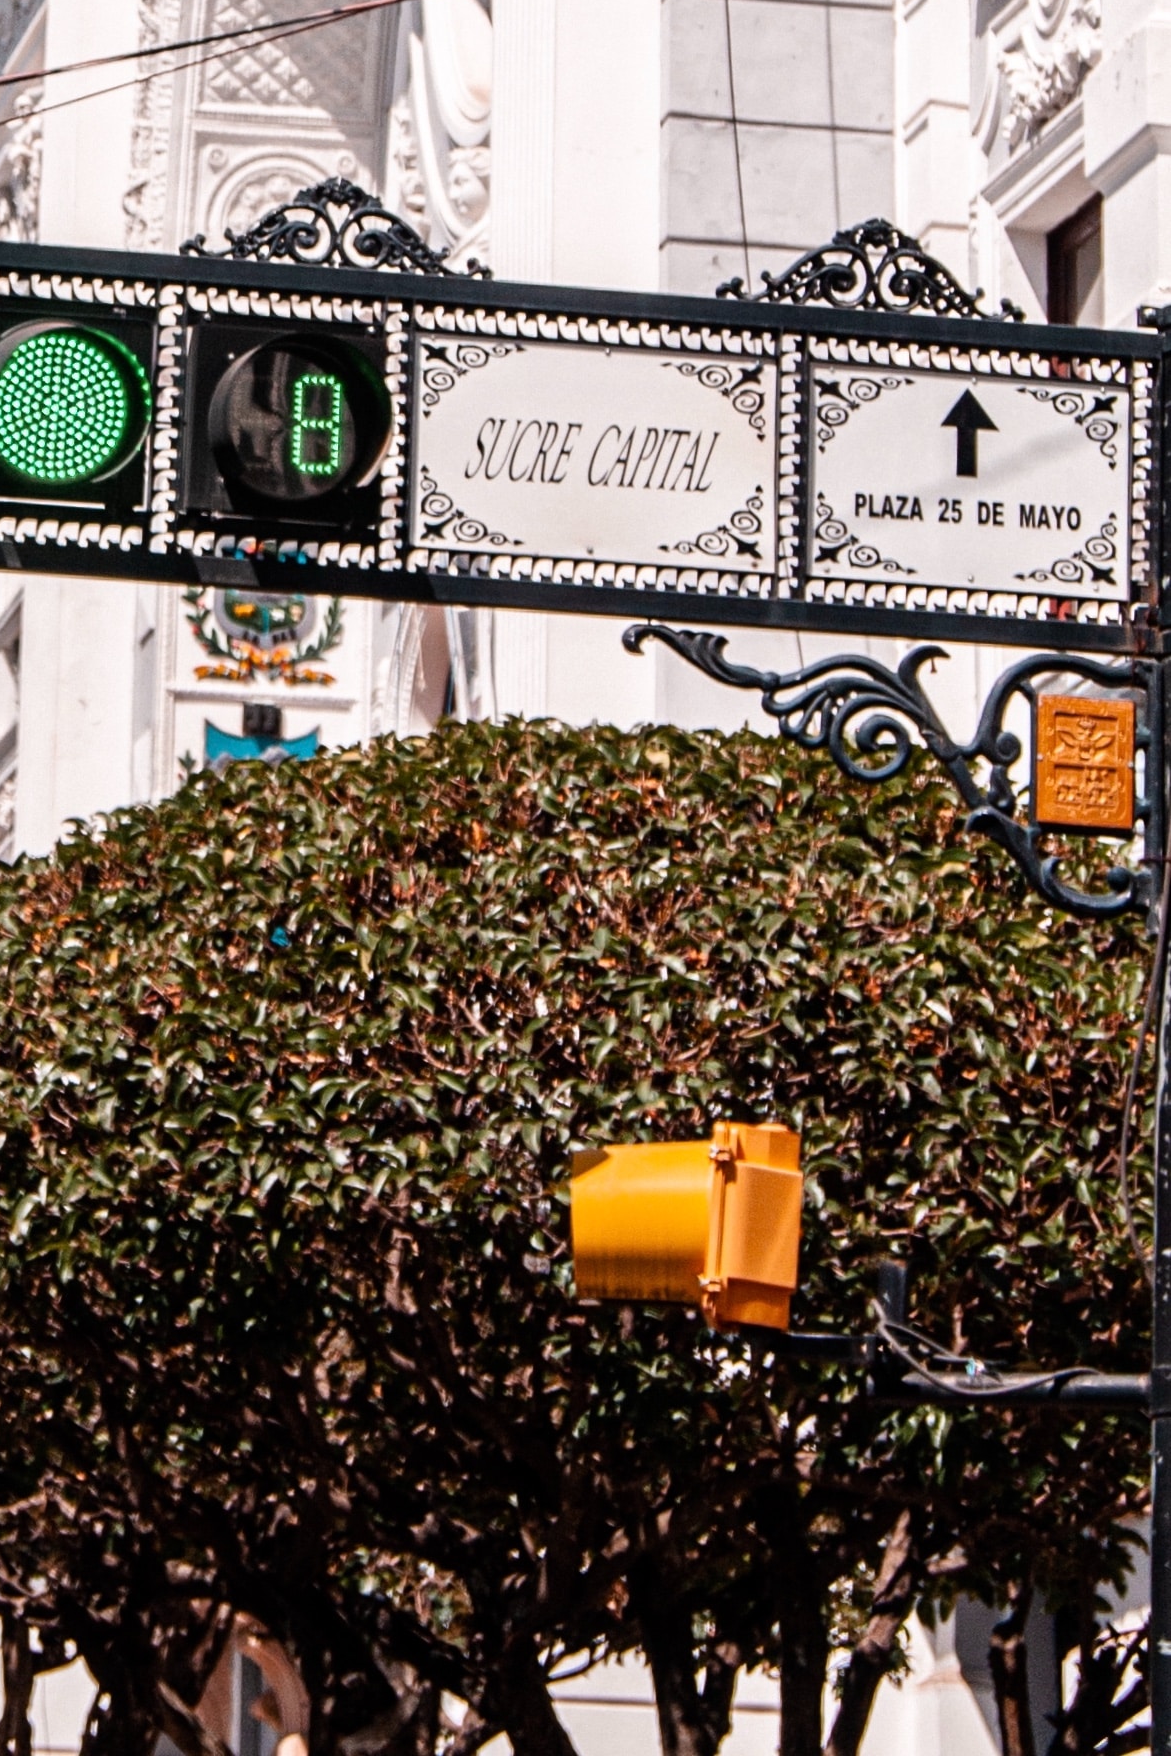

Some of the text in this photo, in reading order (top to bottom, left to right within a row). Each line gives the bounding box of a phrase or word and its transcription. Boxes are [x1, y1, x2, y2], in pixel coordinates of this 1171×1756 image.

[292, 375, 340, 474] 8
[464, 417, 720, 492] SUCRE CAPITAL
[854, 492, 1082, 531] PLAZA 25 DE MAYO
